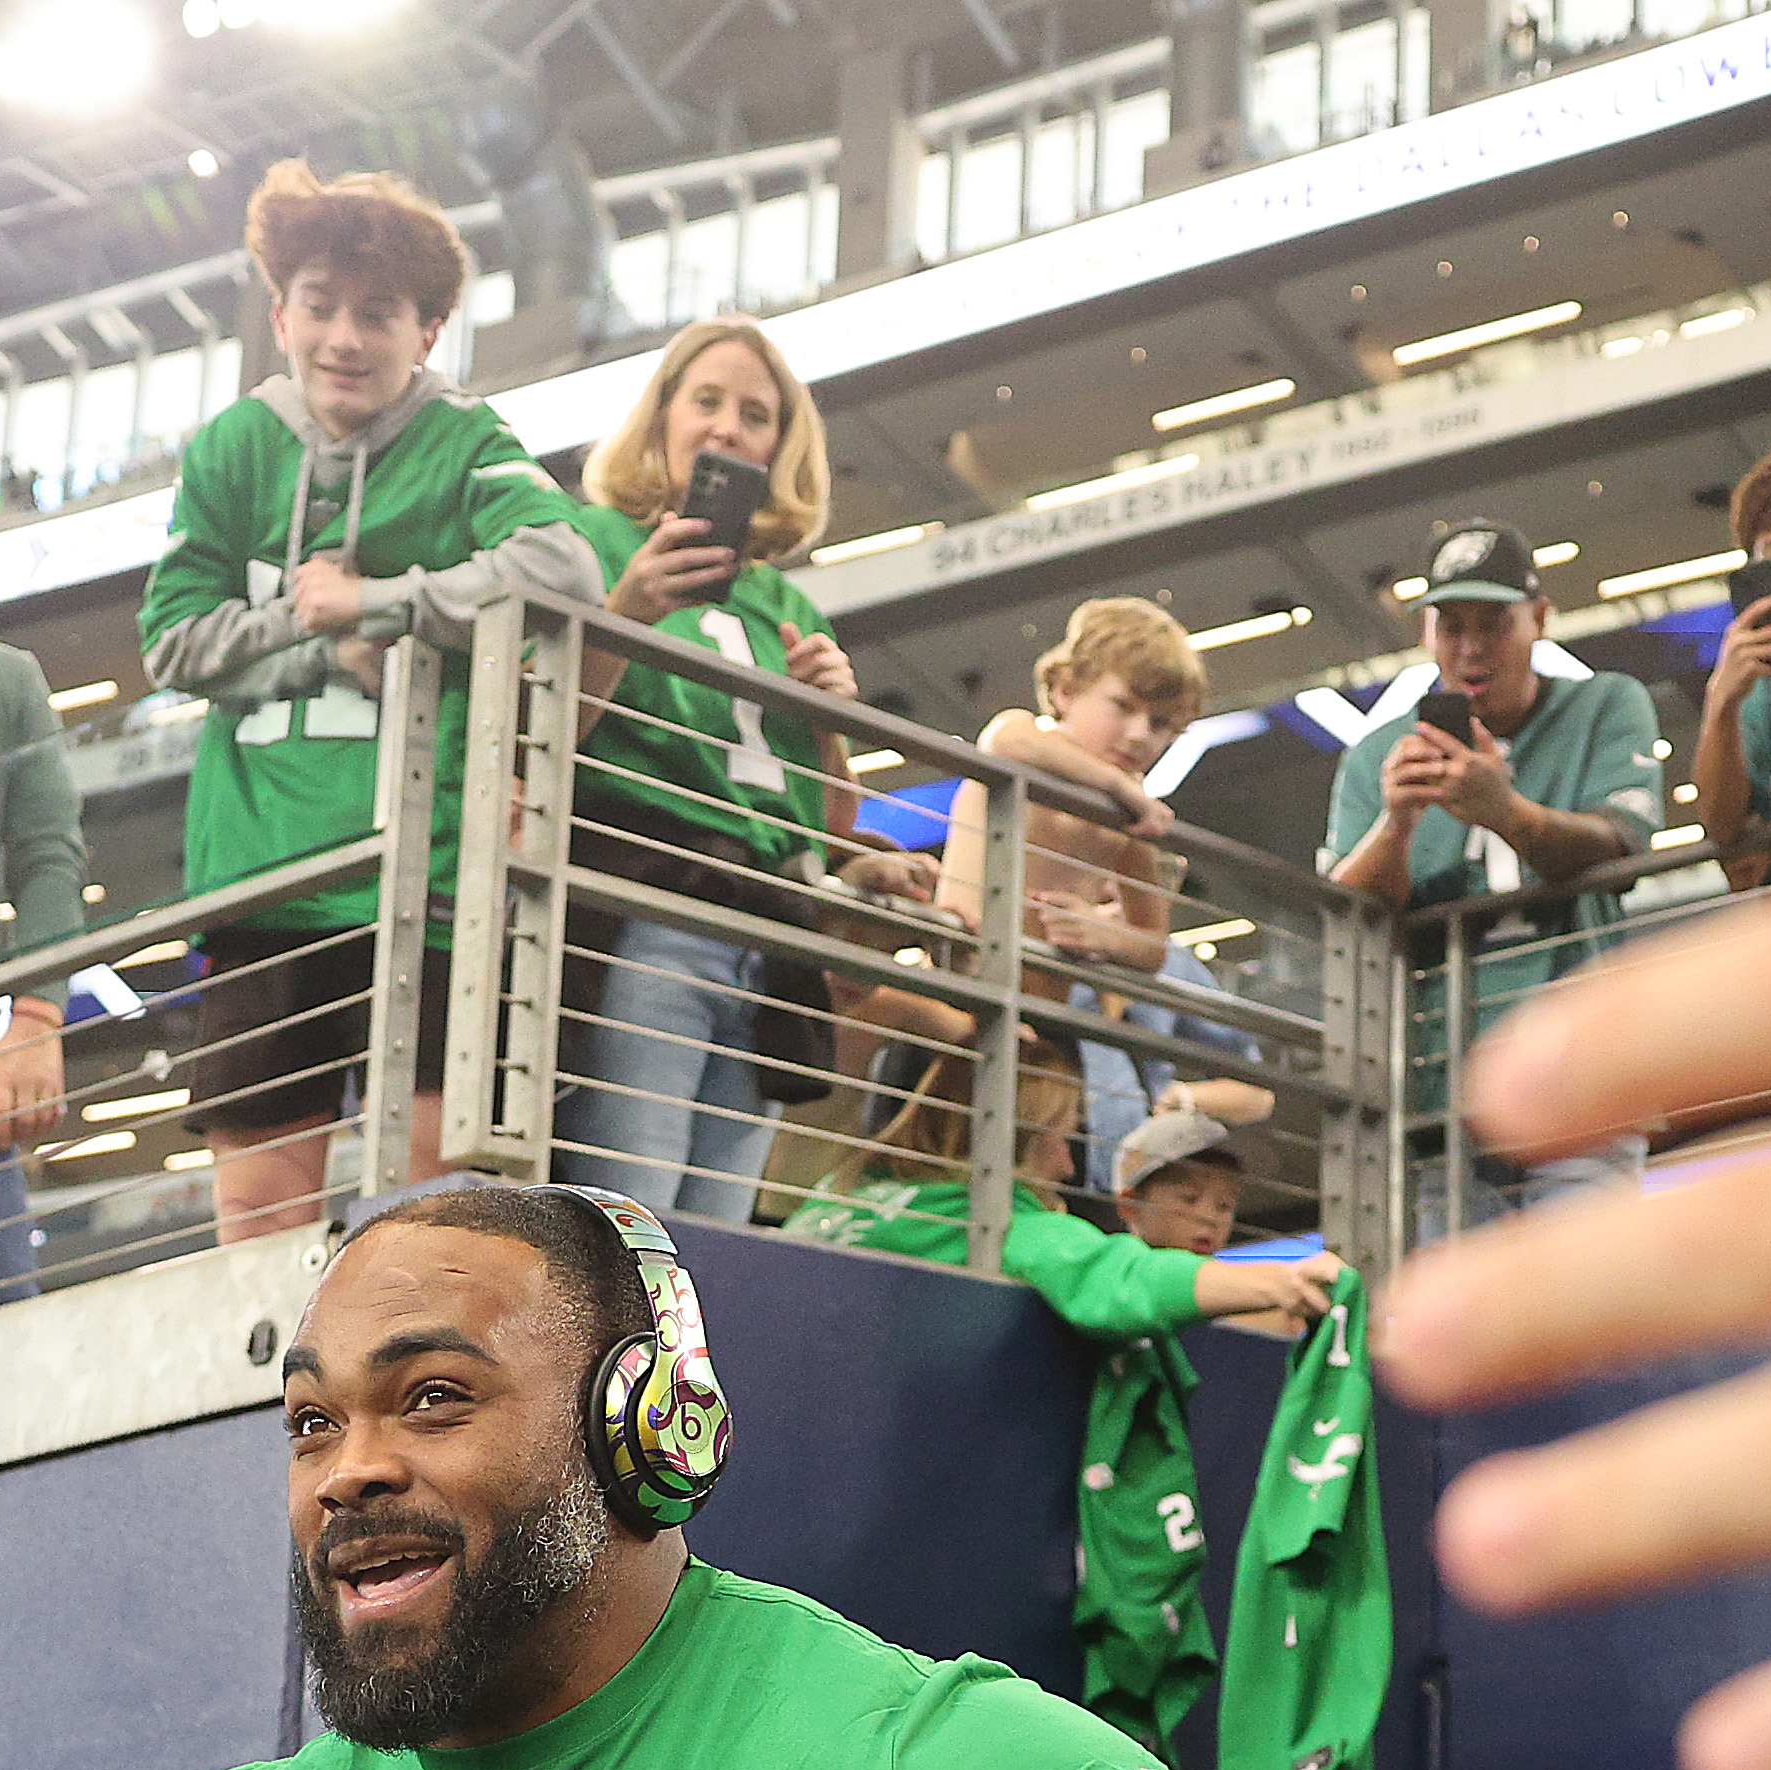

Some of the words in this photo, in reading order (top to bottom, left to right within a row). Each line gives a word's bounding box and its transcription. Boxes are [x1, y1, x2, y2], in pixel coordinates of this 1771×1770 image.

[1356, 103, 1585, 194] DALLAS
[987, 484, 1169, 555] CHARLES
[1181, 446, 1317, 504] HALEY
